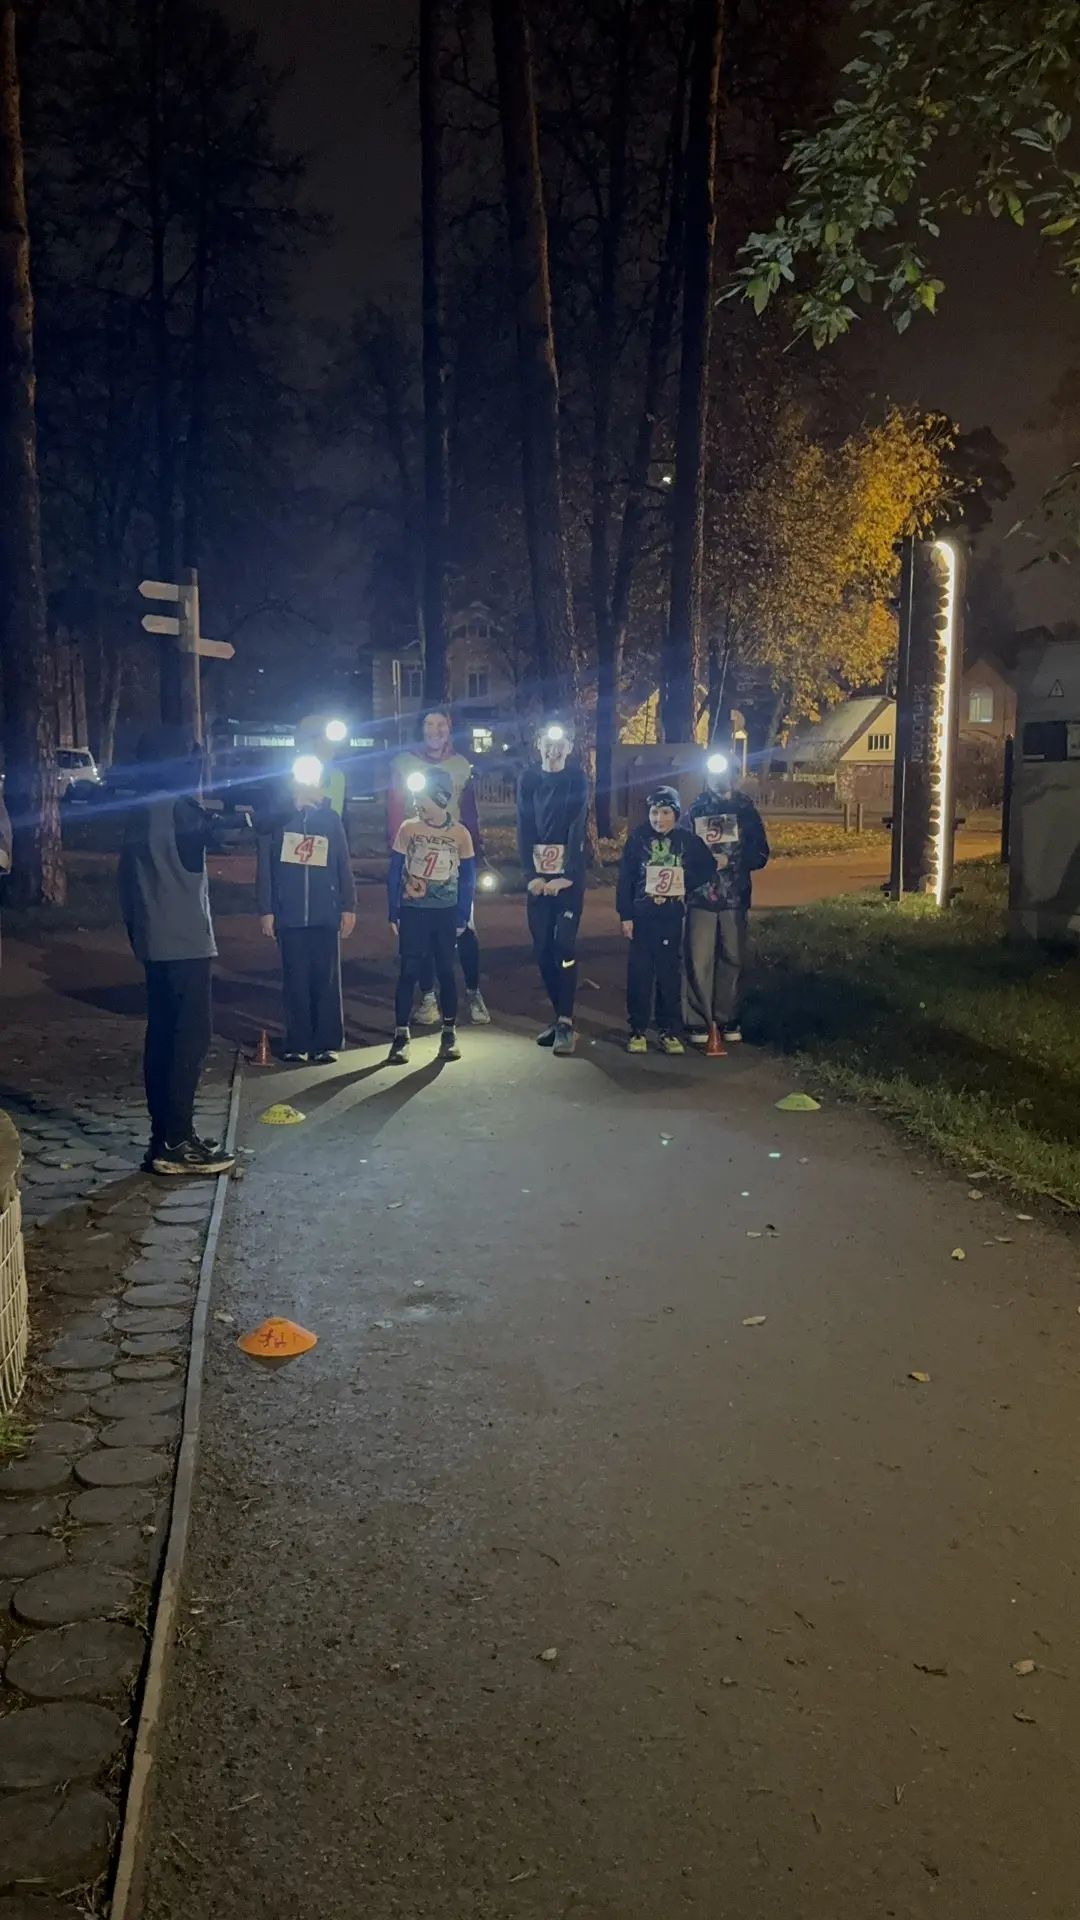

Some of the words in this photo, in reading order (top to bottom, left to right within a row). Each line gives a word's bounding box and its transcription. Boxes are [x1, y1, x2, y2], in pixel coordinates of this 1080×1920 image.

[706, 815, 725, 842] 5
[293, 836, 315, 863] 4
[540, 846, 560, 871] 2
[423, 852, 441, 877] 1
[655, 868, 675, 894] 3
